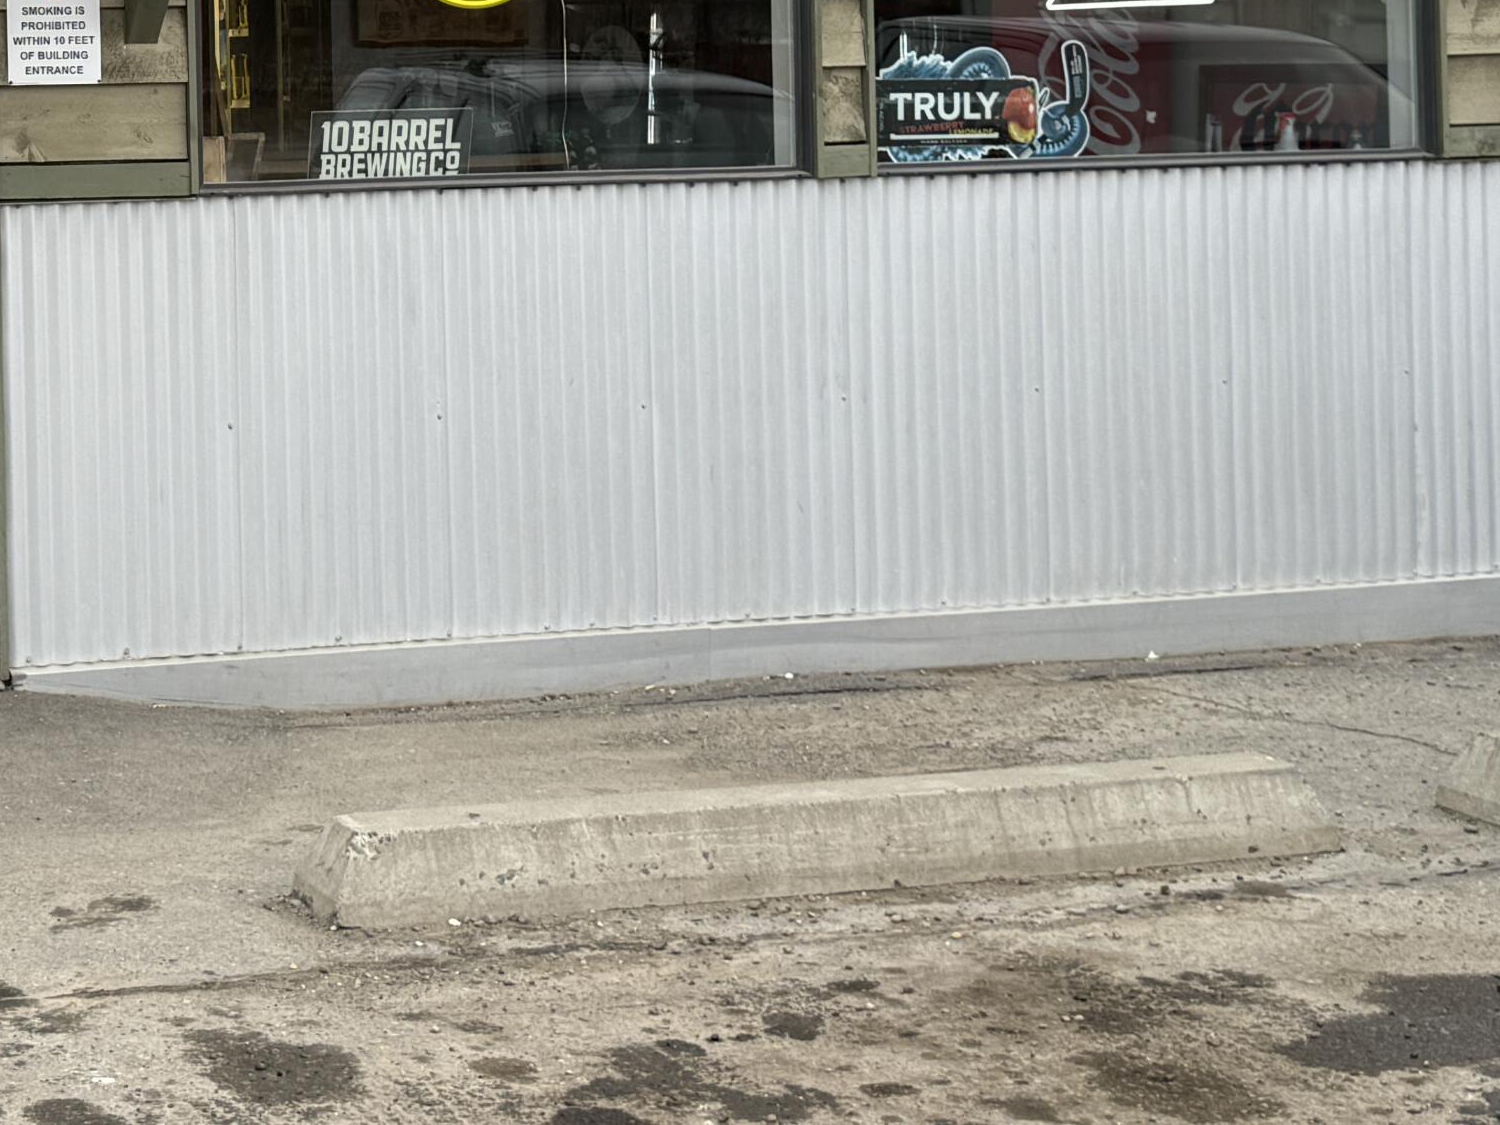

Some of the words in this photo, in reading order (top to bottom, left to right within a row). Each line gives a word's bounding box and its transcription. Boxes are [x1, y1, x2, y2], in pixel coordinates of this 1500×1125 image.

[22, 6, 72, 16] SMOKING
[75, 6, 85, 15] IS
[21, 21, 86, 31] PROHIBITED
[13, 36, 51, 45] WITHIN
[54, 36, 65, 45] 10
[68, 36, 95, 45] FEET
[20, 51, 35, 60] OF
[38, 50, 89, 60] BUILDING
[25, 66, 84, 75] ENTRANCE
[889, 91, 999, 121] TRULY
[900, 121, 965, 134] STRAWBERRY
